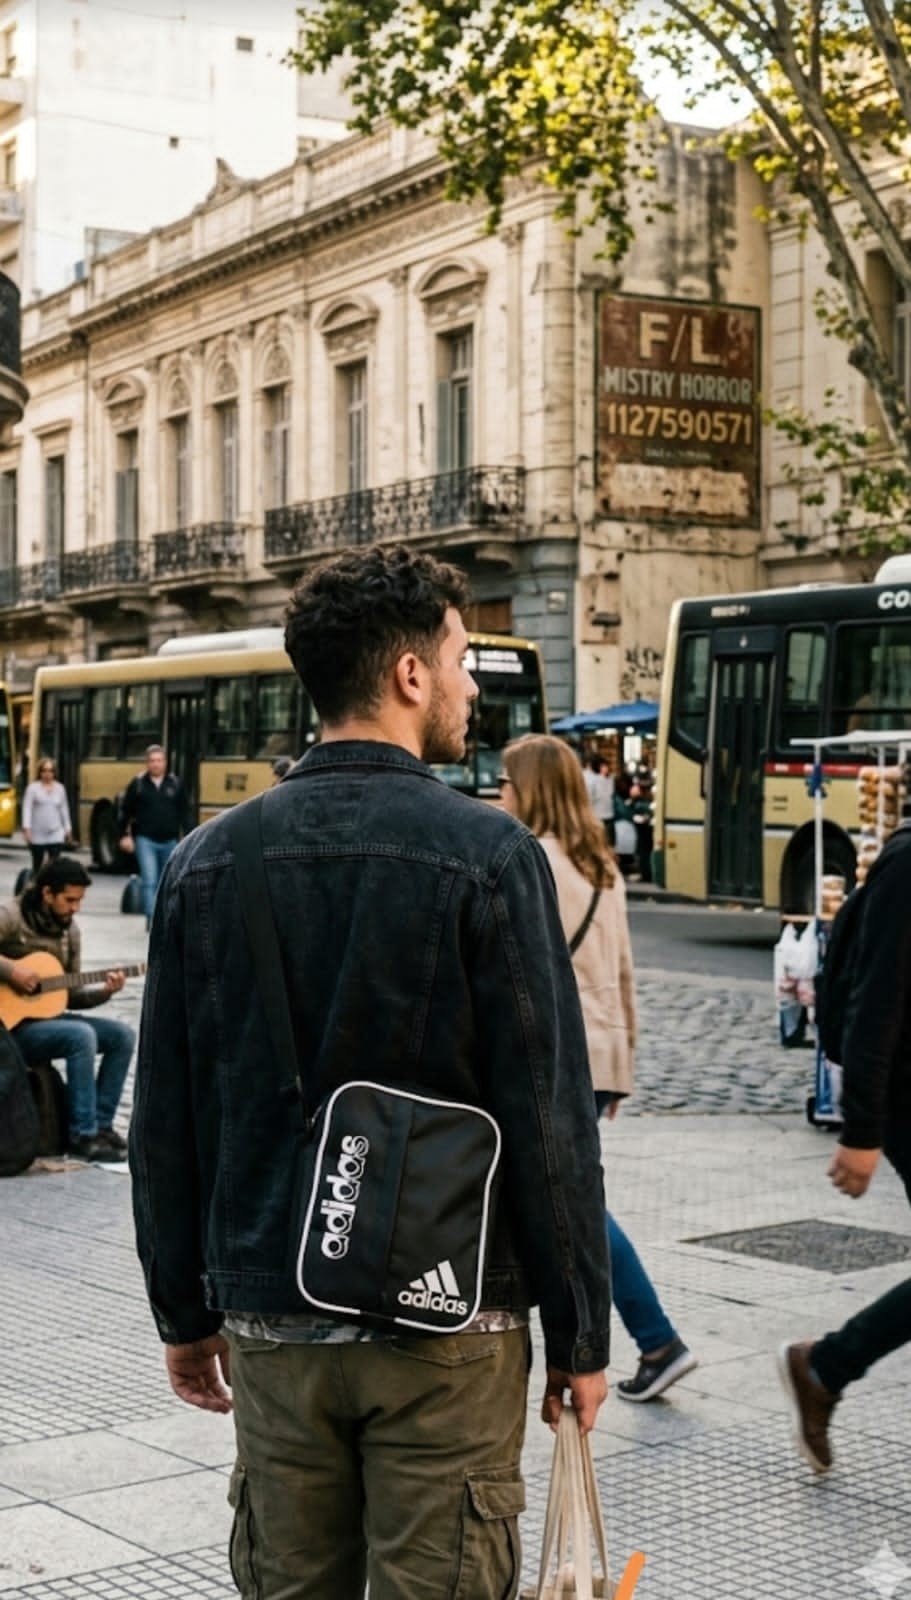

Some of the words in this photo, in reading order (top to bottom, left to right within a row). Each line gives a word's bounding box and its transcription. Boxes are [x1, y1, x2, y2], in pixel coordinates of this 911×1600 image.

[603, 366, 675, 397] MISTRY
[681, 375, 752, 402] HORROR
[608, 403, 752, 444] 1127590571
[878, 590, 911, 610] CO
[321, 1135, 369, 1260] adidas
[398, 1290, 468, 1315] adidas
